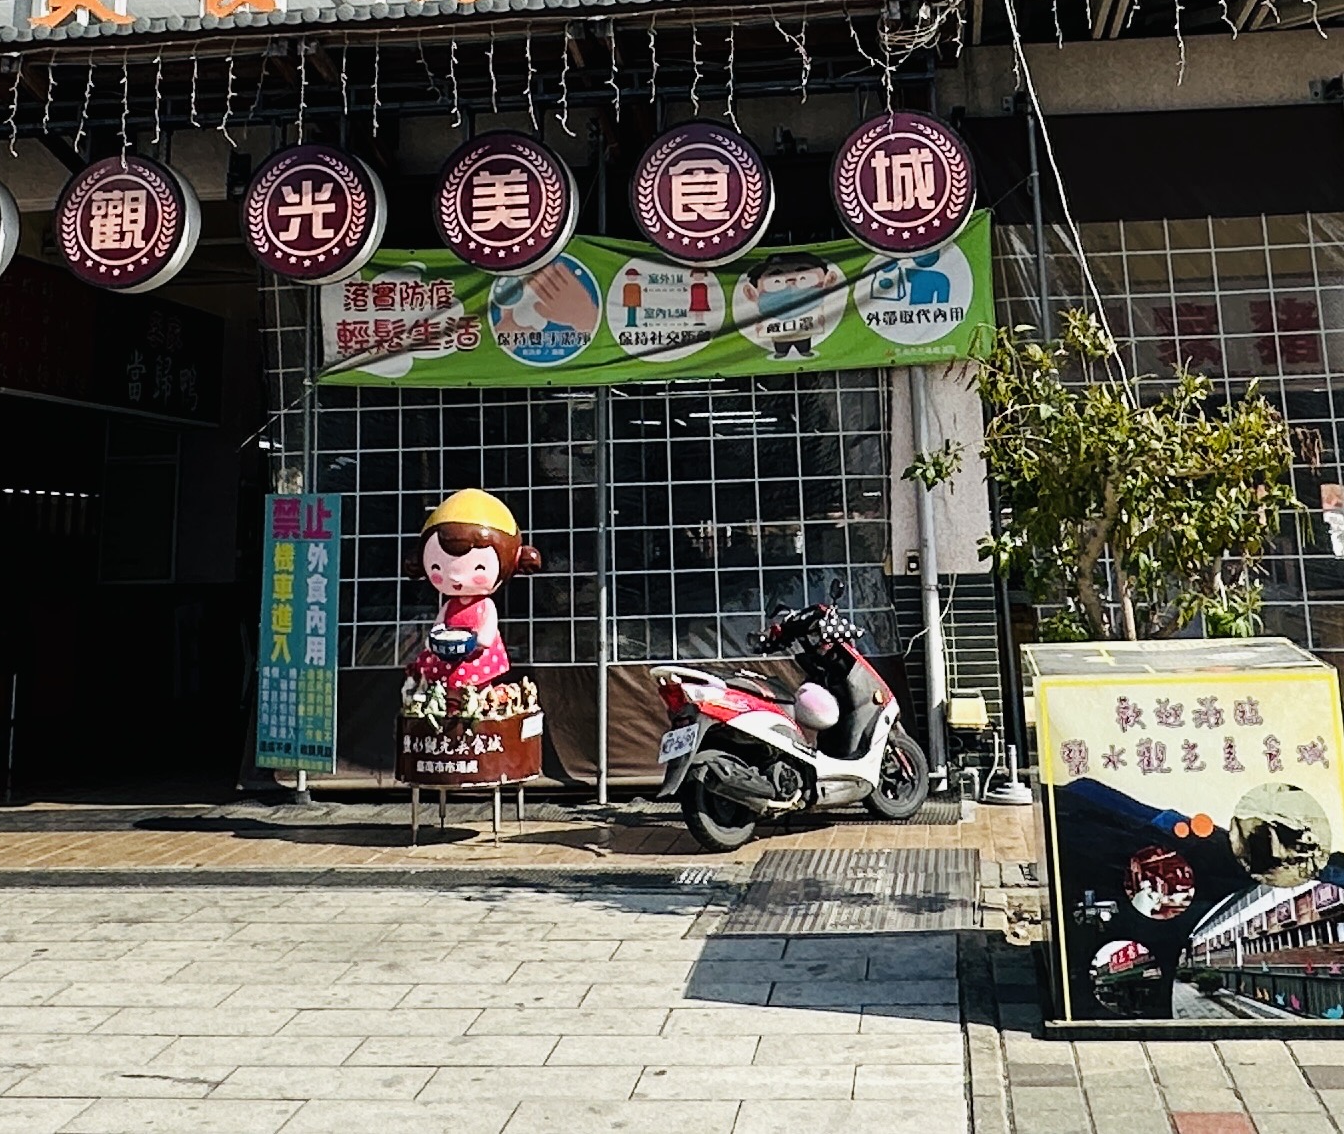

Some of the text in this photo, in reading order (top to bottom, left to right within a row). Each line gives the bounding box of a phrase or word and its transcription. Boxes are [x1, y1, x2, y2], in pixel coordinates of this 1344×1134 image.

[343, 280, 455, 312] 落實防疫
[866, 307, 964, 326] 外帶取代內用
[336, 316, 481, 357] 輕鬆生活
[272, 497, 333, 539] 禁止
[270, 541, 296, 664] 機車進入
[305, 542, 329, 666] 外食內用
